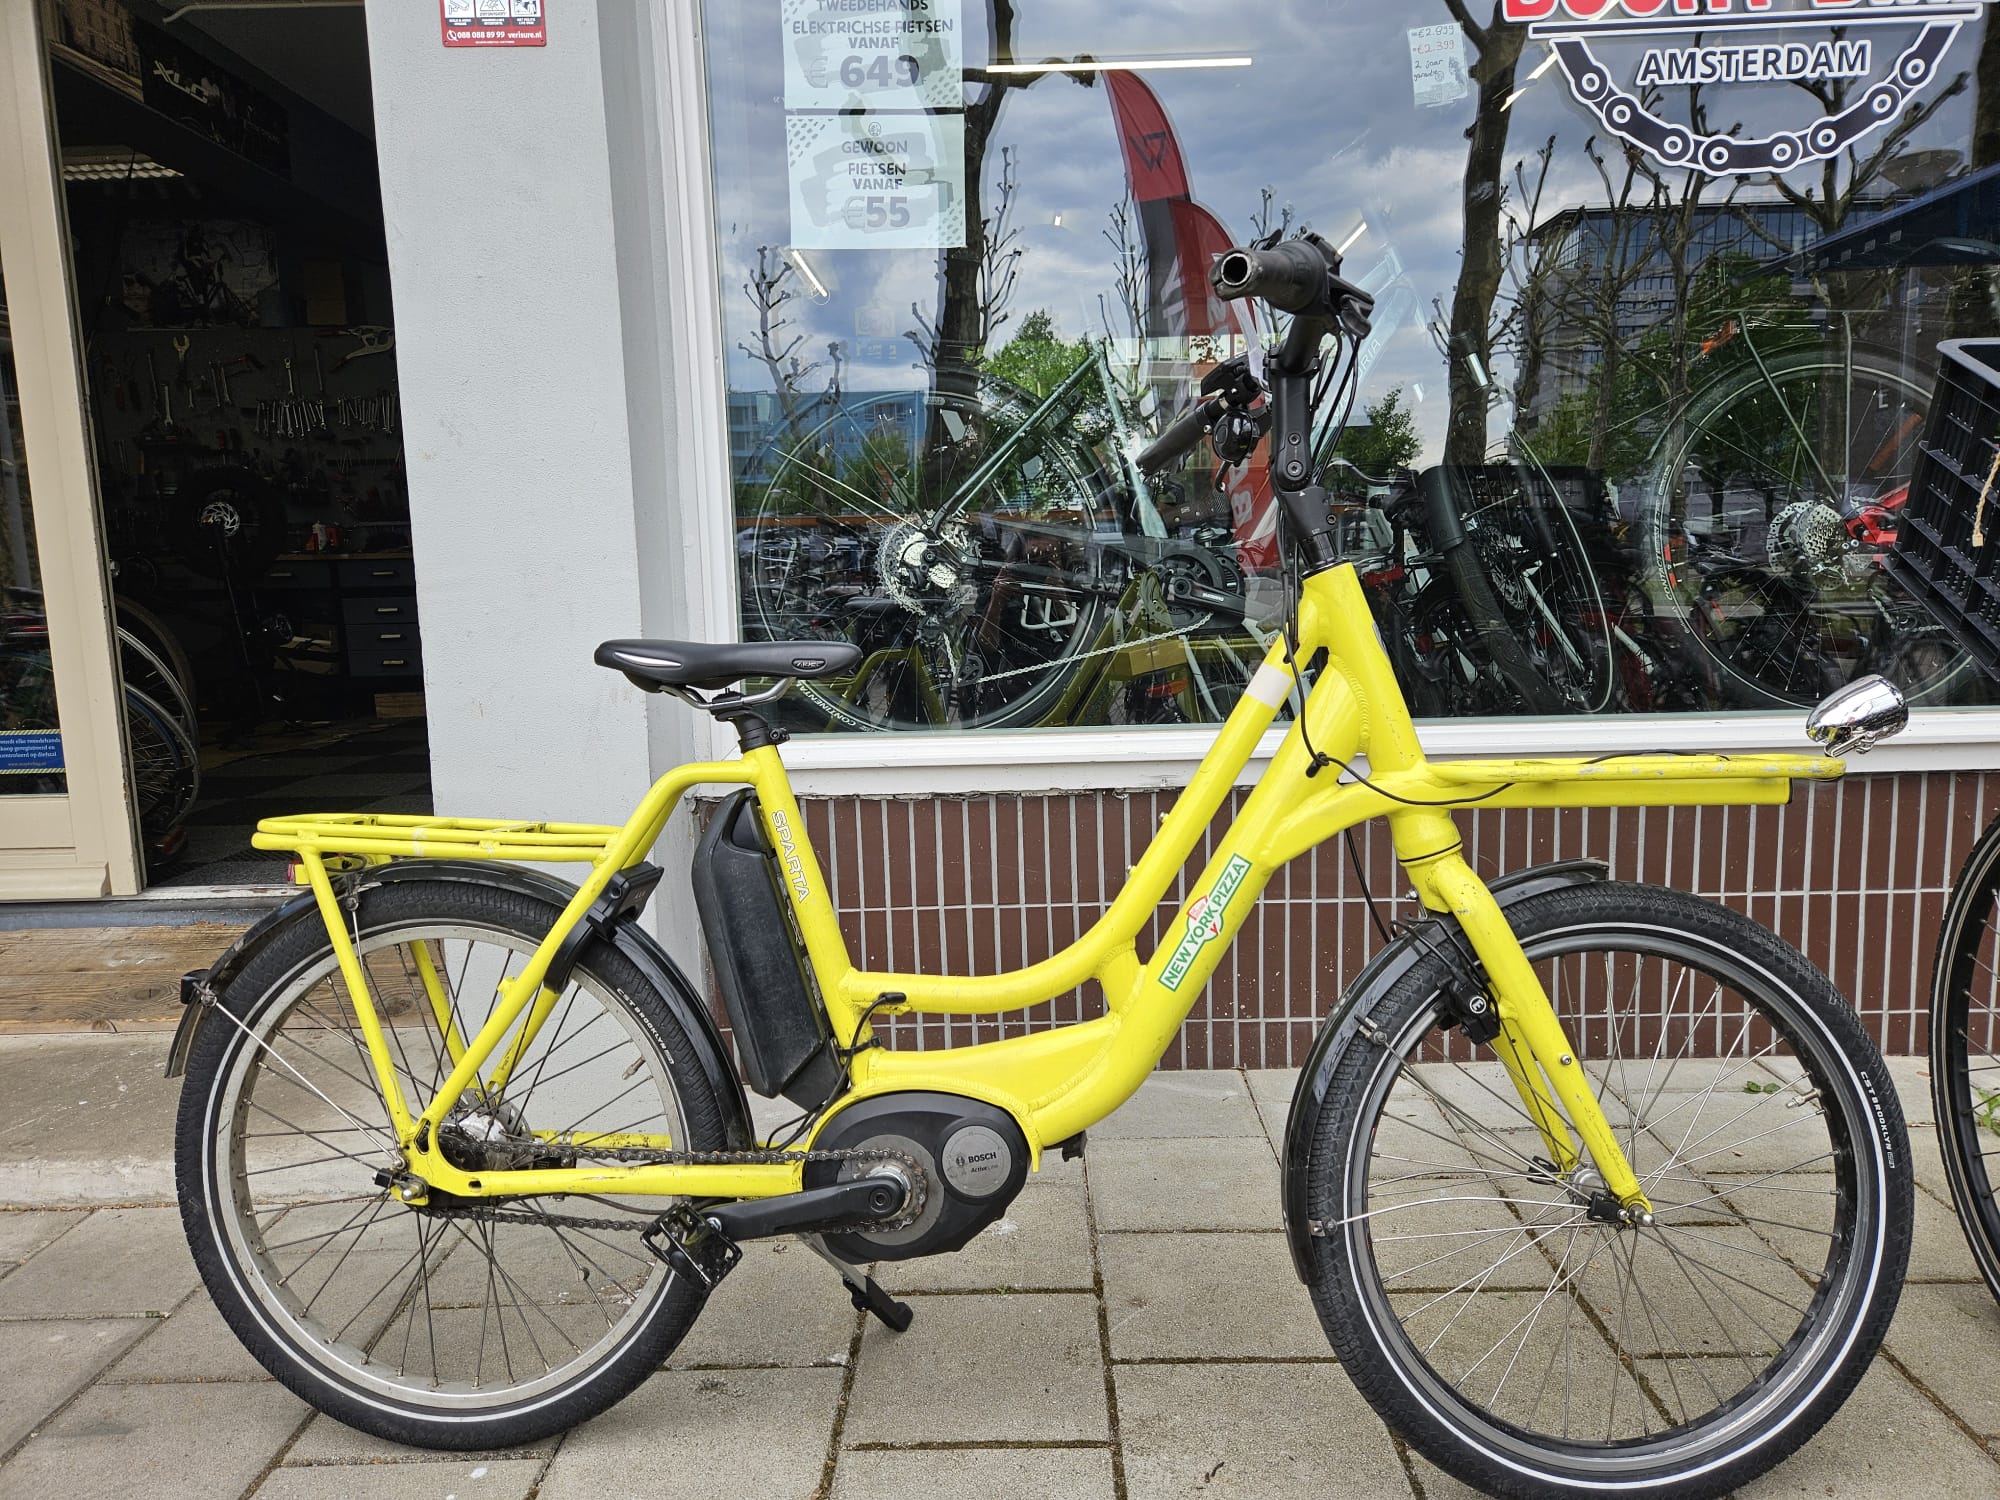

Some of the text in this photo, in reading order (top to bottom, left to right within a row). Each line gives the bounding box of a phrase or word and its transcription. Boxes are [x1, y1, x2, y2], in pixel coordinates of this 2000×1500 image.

[818, 0, 929, 11] TWEEDEHANDS
[792, 19, 953, 34] ELEKTRICHSE FIETSEN
[457, 31, 470, 39] 088
[472, 31, 485, 39] 088
[507, 31, 542, 39] verisure.nl
[848, 37, 899, 49] VANAF
[1637, 41, 1870, 86] AMSTERDAM
[842, 140, 908, 154] GEWOON
[848, 162, 907, 176] FIETSEN
[853, 178, 903, 190] VANAF
[771, 810, 810, 904] SPARTA
[1163, 947, 1192, 986] NEW
[1186, 906, 1219, 946] YORK
[1211, 862, 1246, 907] PIZZA
[616, 987, 668, 1050] CST BROOKLYN
[1860, 1070, 1877, 1096] CST
[1871, 1096, 1893, 1150] BROOKLYN
[967, 1151, 998, 1164] BOSCH
